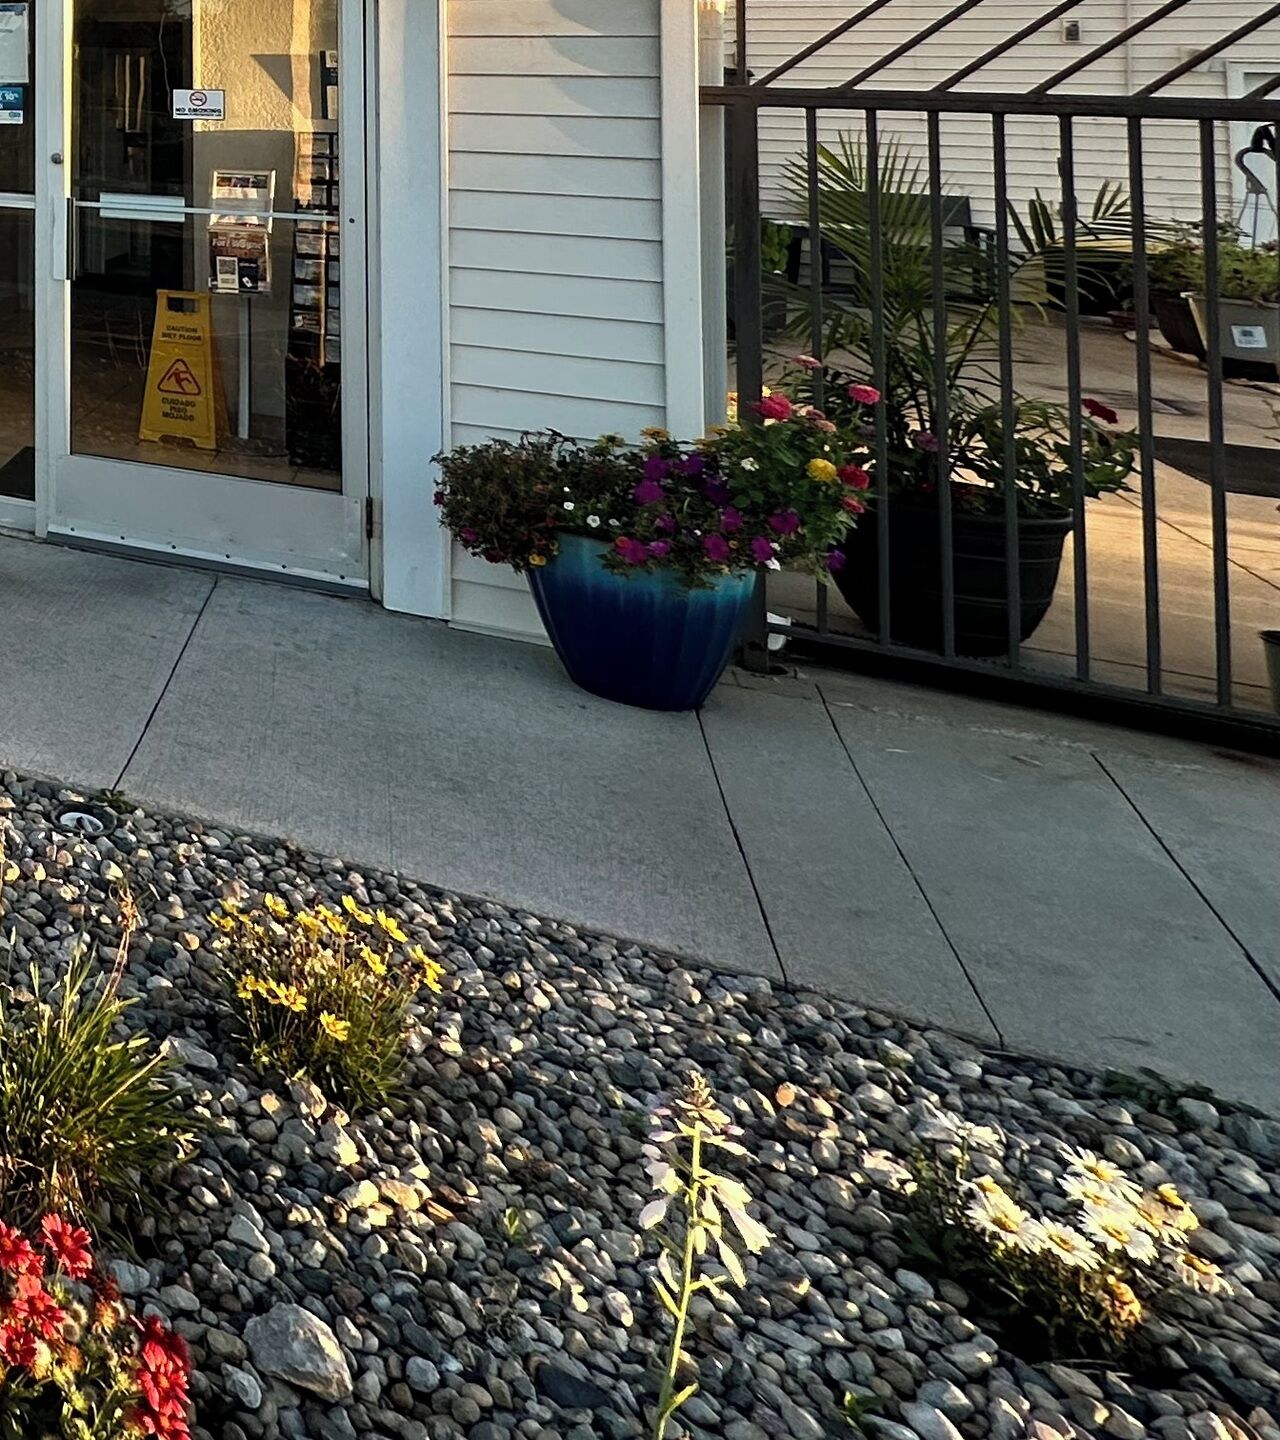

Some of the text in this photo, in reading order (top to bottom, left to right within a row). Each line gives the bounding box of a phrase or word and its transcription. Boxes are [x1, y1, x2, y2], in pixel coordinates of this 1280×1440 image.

[166, 325, 198, 334] CAUTION
[161, 332, 202, 342] WET FLOOR
[161, 397, 196, 408] CUIDADO
[162, 411, 195, 422] MOJADO
